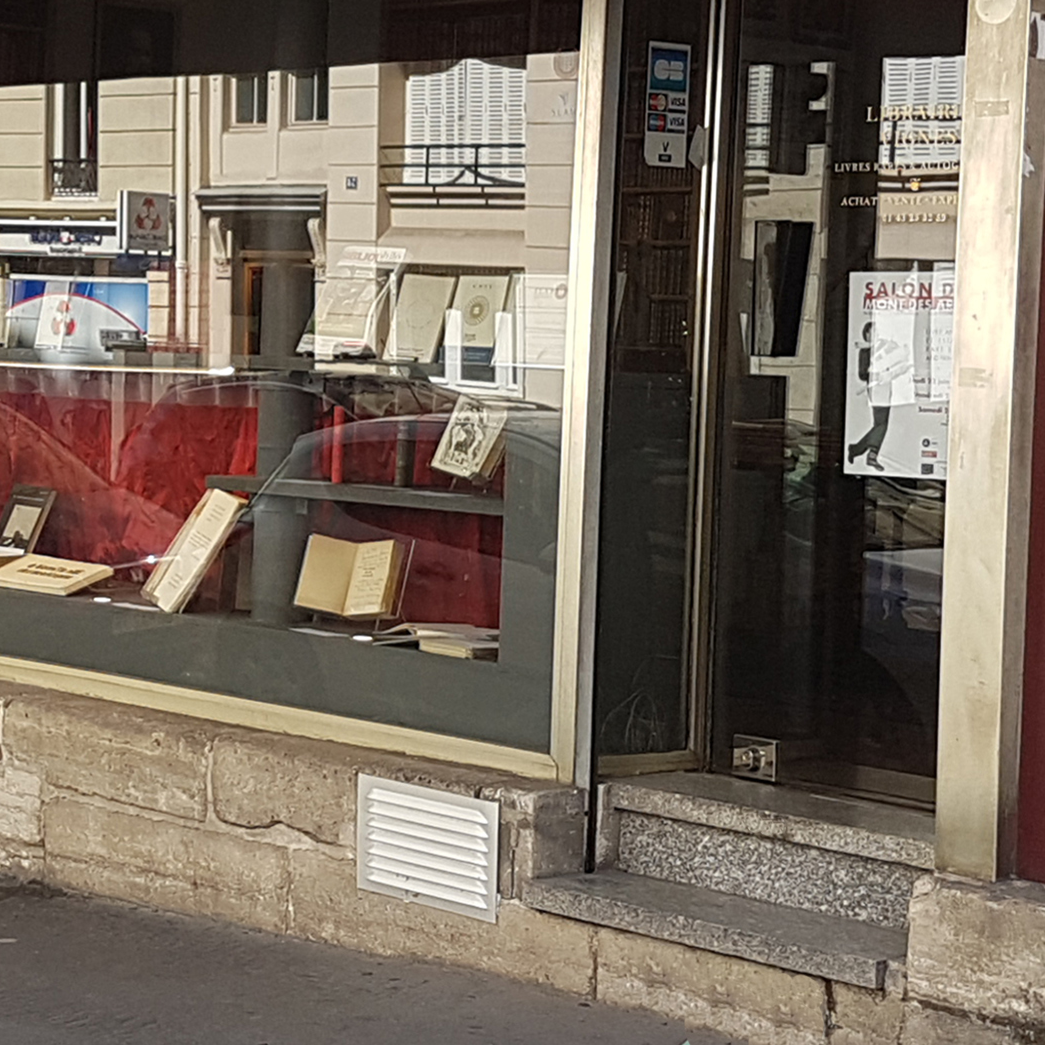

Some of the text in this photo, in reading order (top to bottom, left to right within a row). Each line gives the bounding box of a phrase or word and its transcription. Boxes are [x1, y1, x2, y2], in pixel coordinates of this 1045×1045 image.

[670, 97, 686, 107] VISA
[668, 117, 685, 127] VISA
[834, 162, 871, 173] LIVRES
[840, 196, 878, 207] ACHAT
[864, 281, 933, 298] SALON
